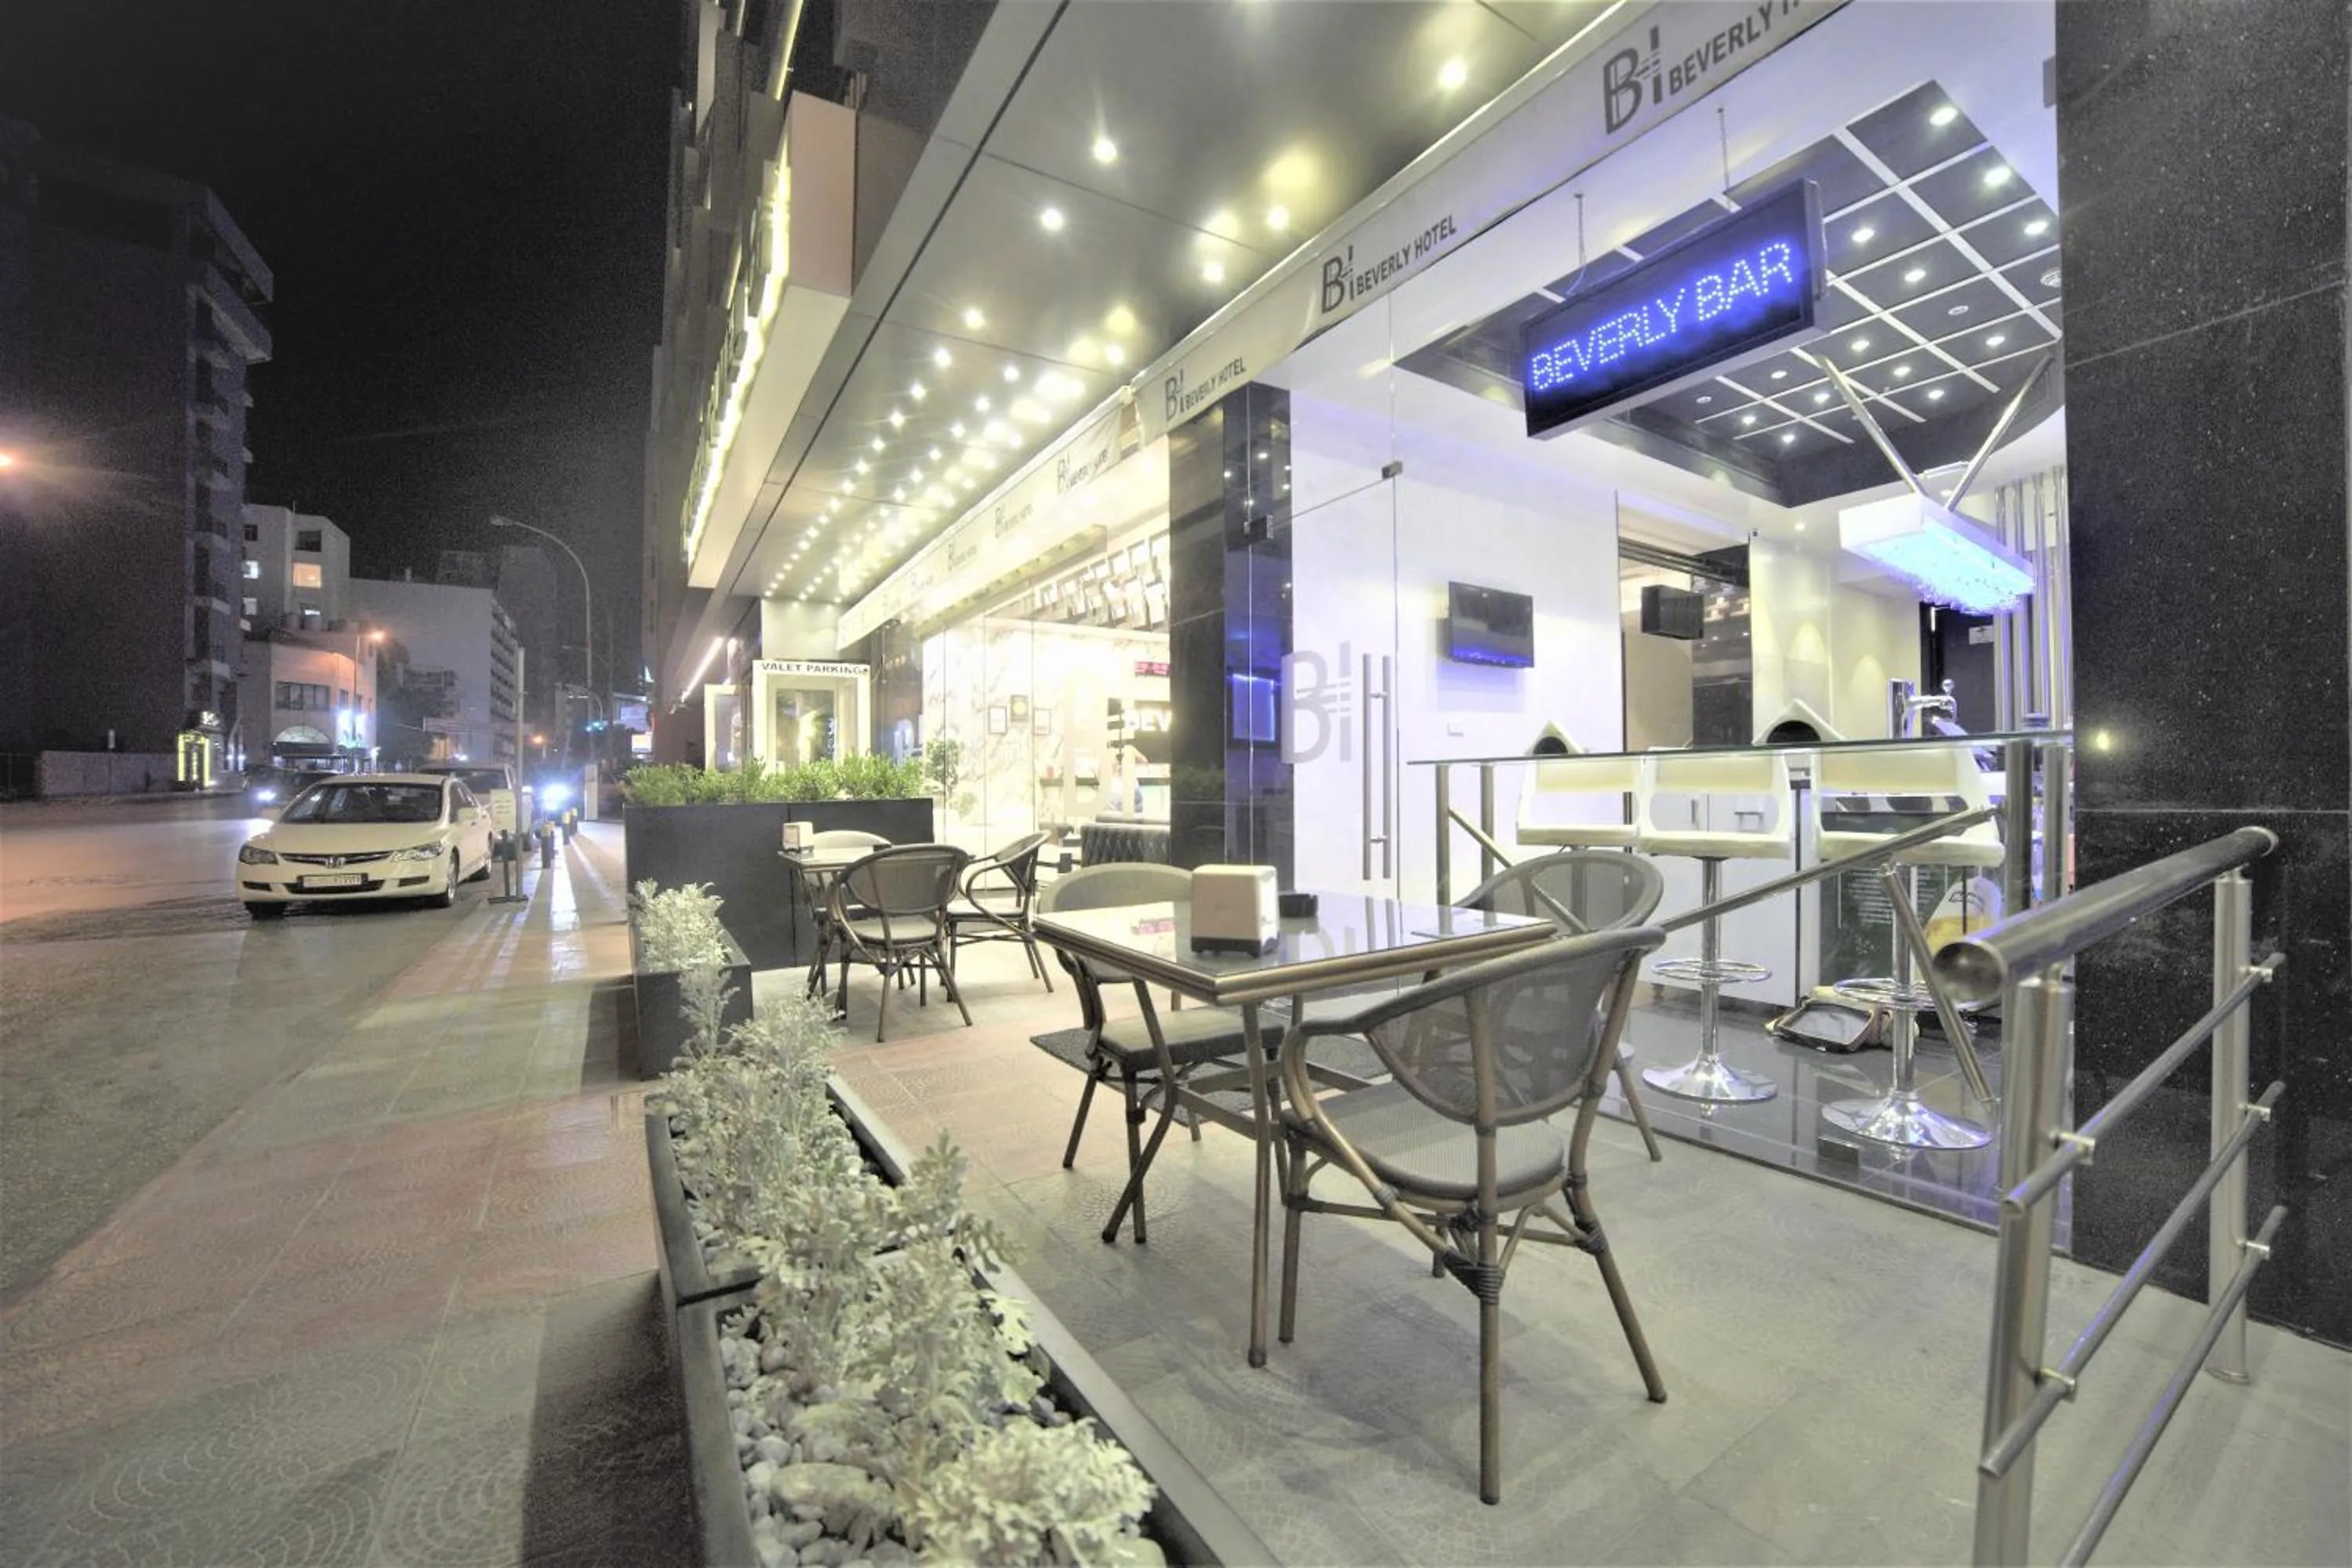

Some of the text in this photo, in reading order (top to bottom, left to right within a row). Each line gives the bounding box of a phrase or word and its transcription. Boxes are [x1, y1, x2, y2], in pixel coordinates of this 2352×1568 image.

[1668, 0, 1773, 96] BEVERLY
[1356, 214, 1457, 296] BEVERLY HOTEL
[1531, 241, 1794, 390] BEVERLY BAR
[761, 662, 862, 674] VALET PARKING
